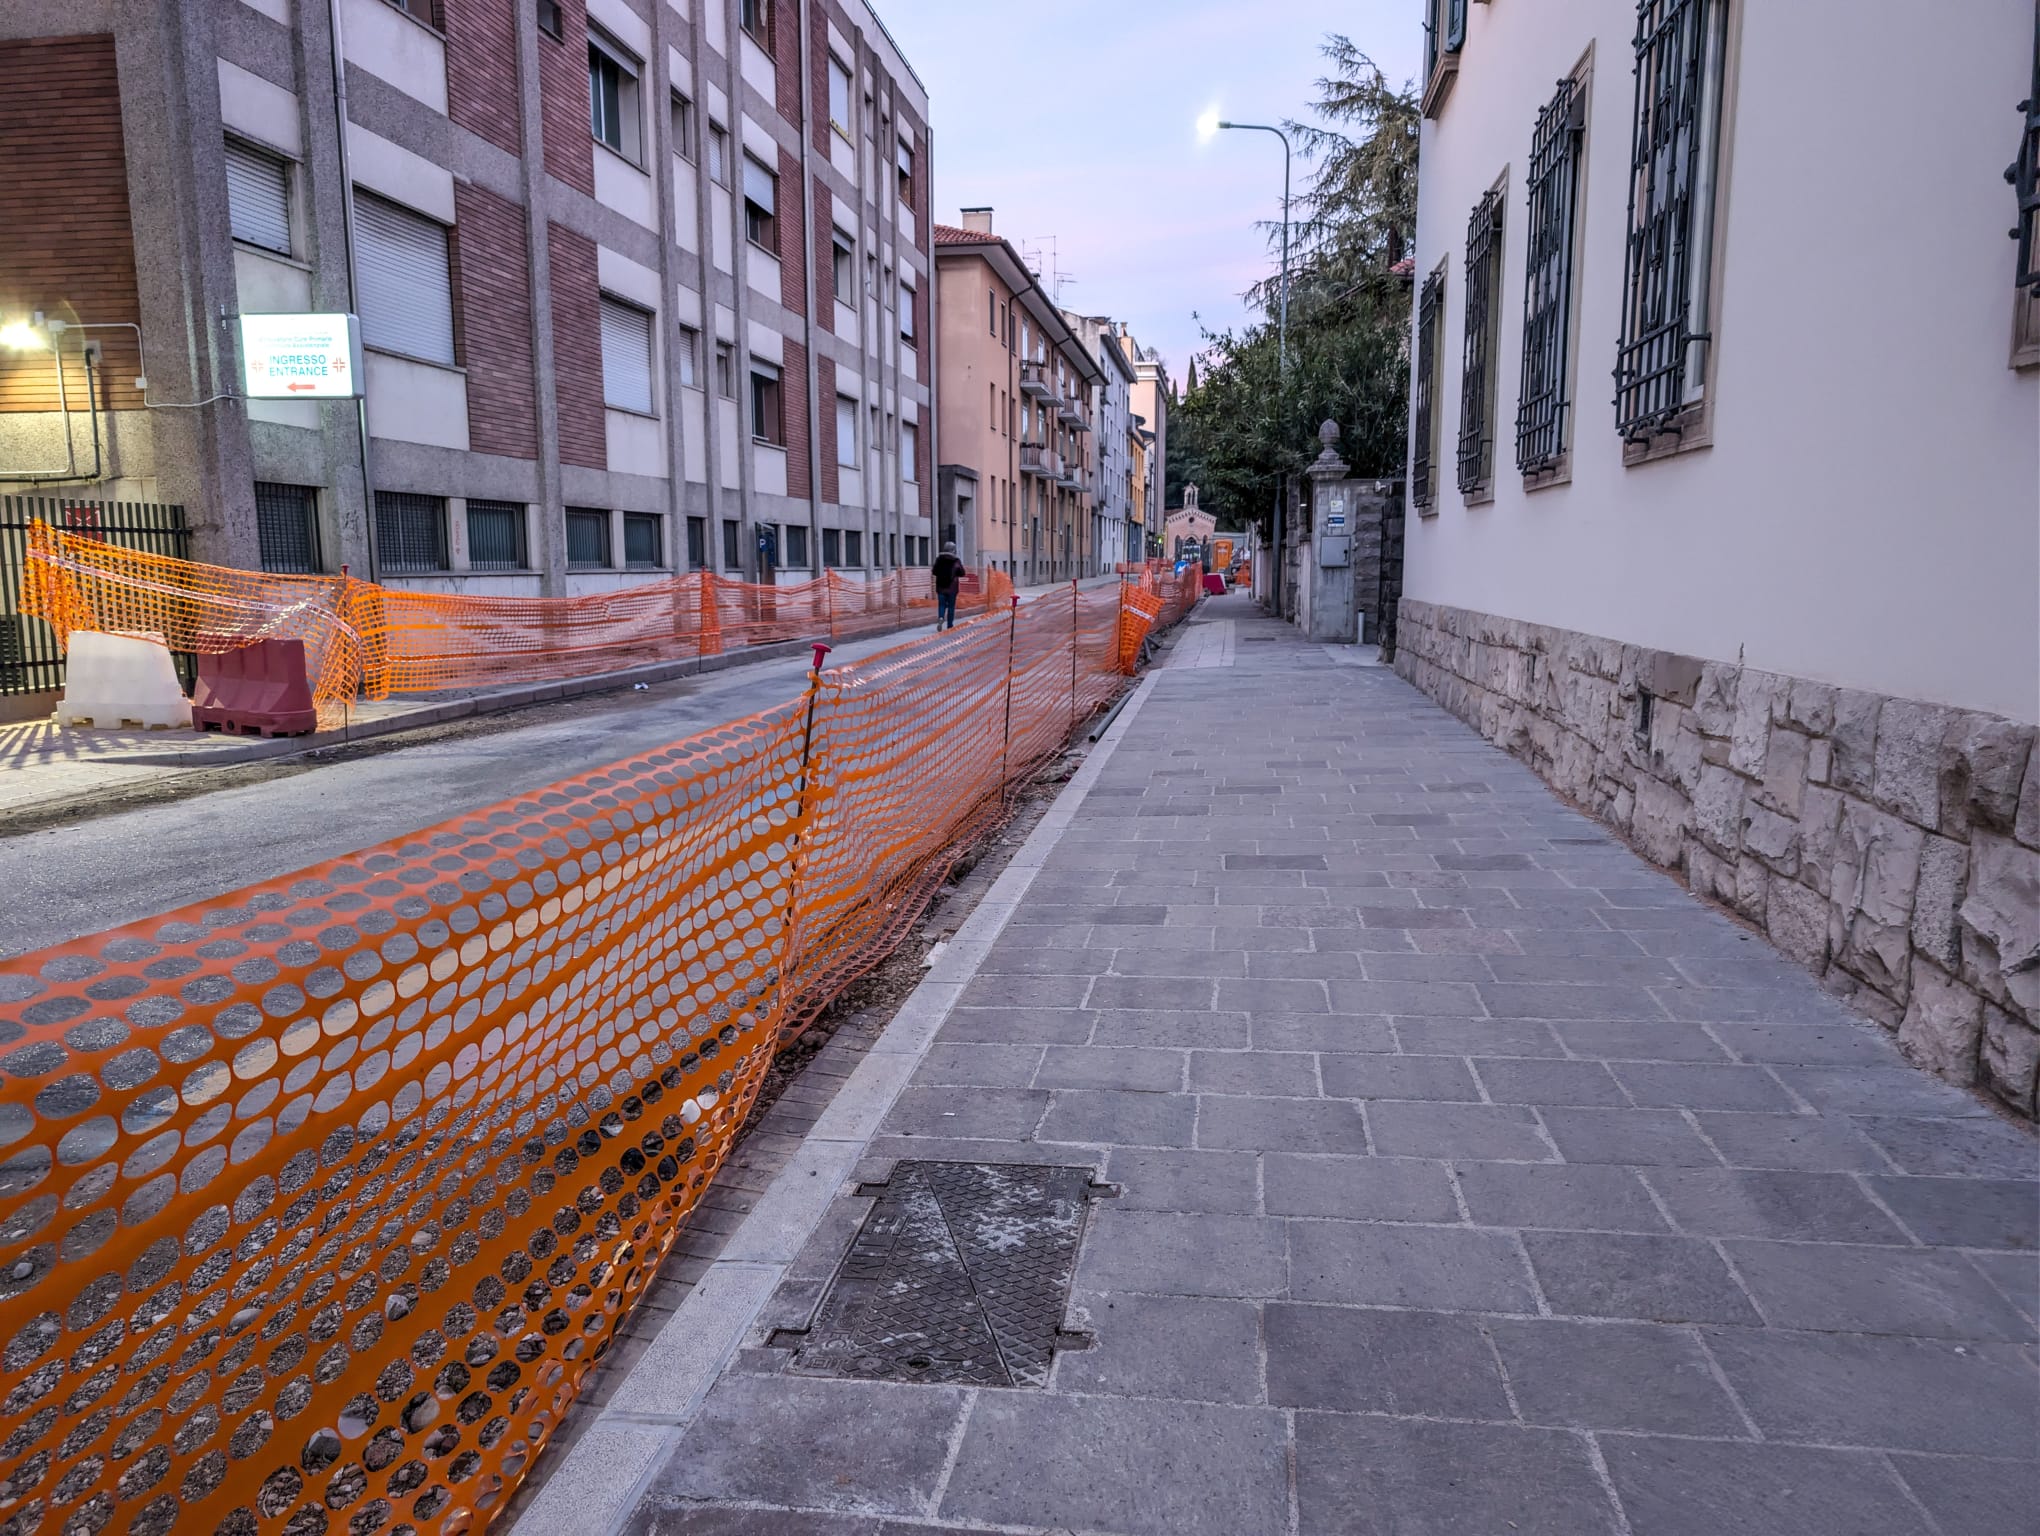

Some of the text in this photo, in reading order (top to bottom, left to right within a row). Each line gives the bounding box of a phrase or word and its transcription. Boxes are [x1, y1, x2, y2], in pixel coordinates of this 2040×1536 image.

[269, 355, 326, 365] INGRESSO
[269, 366, 328, 376] ENTRANCE
[759, 538, 767, 548] P
